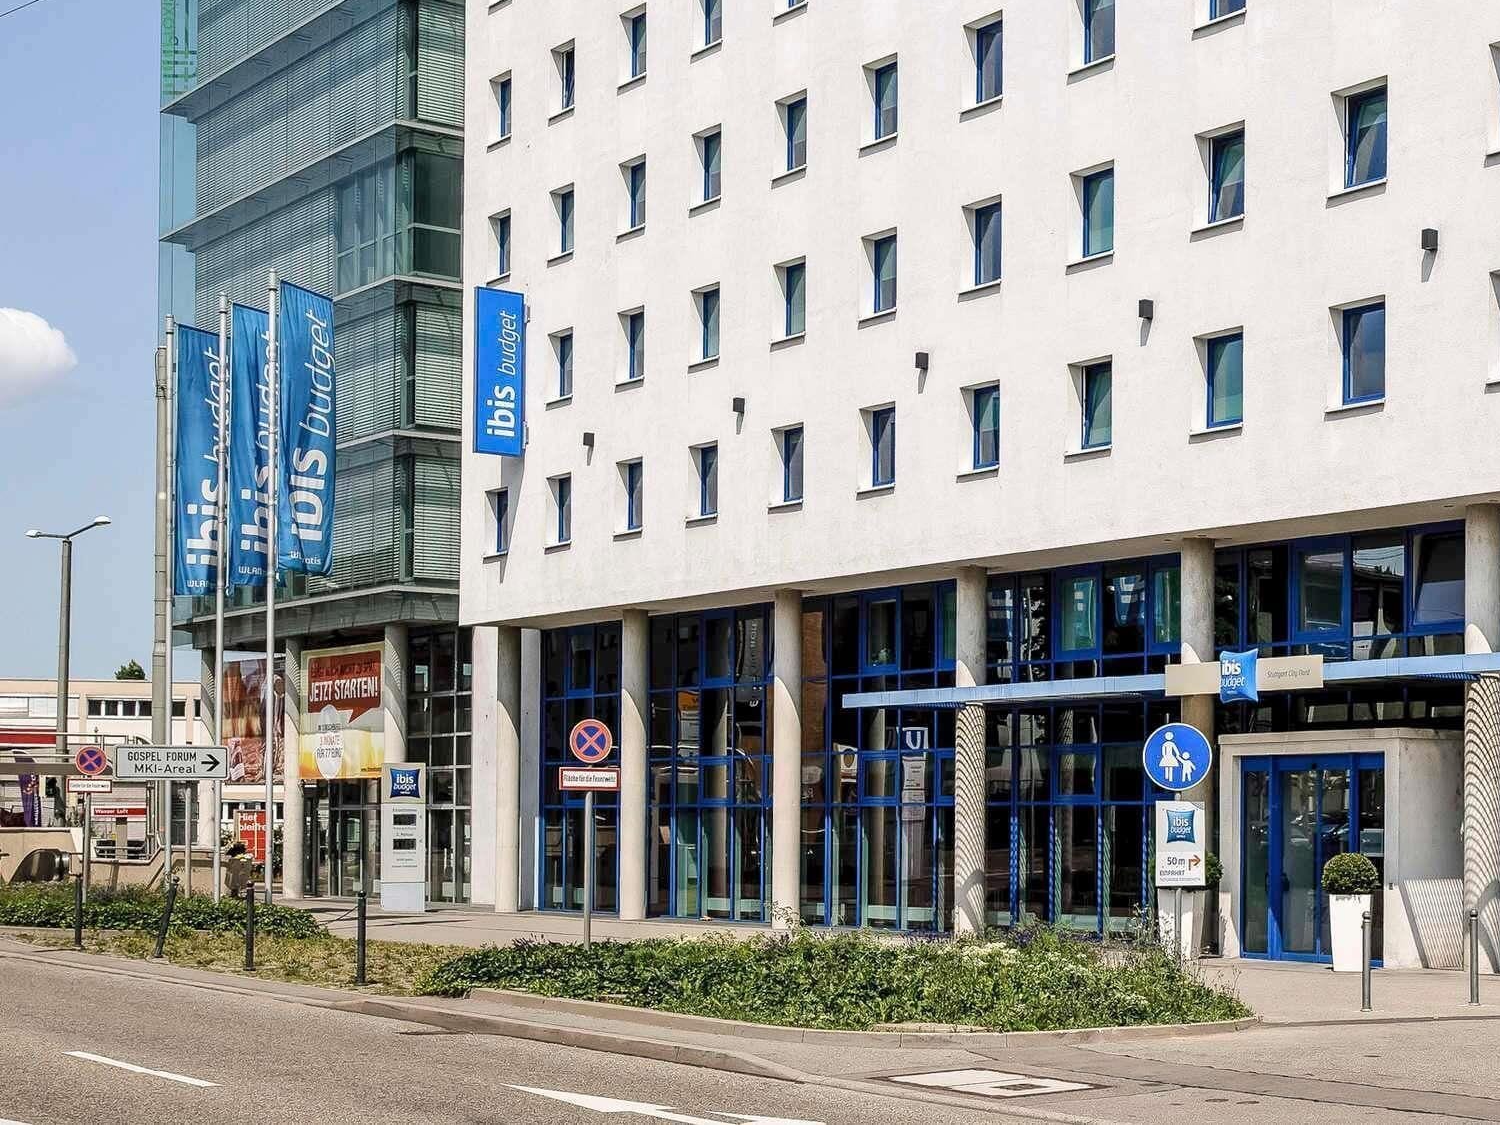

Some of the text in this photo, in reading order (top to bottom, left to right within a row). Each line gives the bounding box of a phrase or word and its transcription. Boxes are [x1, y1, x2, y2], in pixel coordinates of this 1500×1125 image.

[298, 309, 336, 439] budget
[486, 309, 521, 438] ibis budget
[1221, 658, 1241, 675] ibis
[309, 676, 378, 702] JETZT STARTEN!
[127, 751, 197, 761] GOSPEL FORUM
[134, 763, 196, 774] MKI-Areal
[396, 773, 414, 784] ibis
[393, 782, 417, 791] budget
[1173, 816, 1189, 826] ibis
[1170, 825, 1192, 835] budget
[1167, 857, 1177, 865] 50
